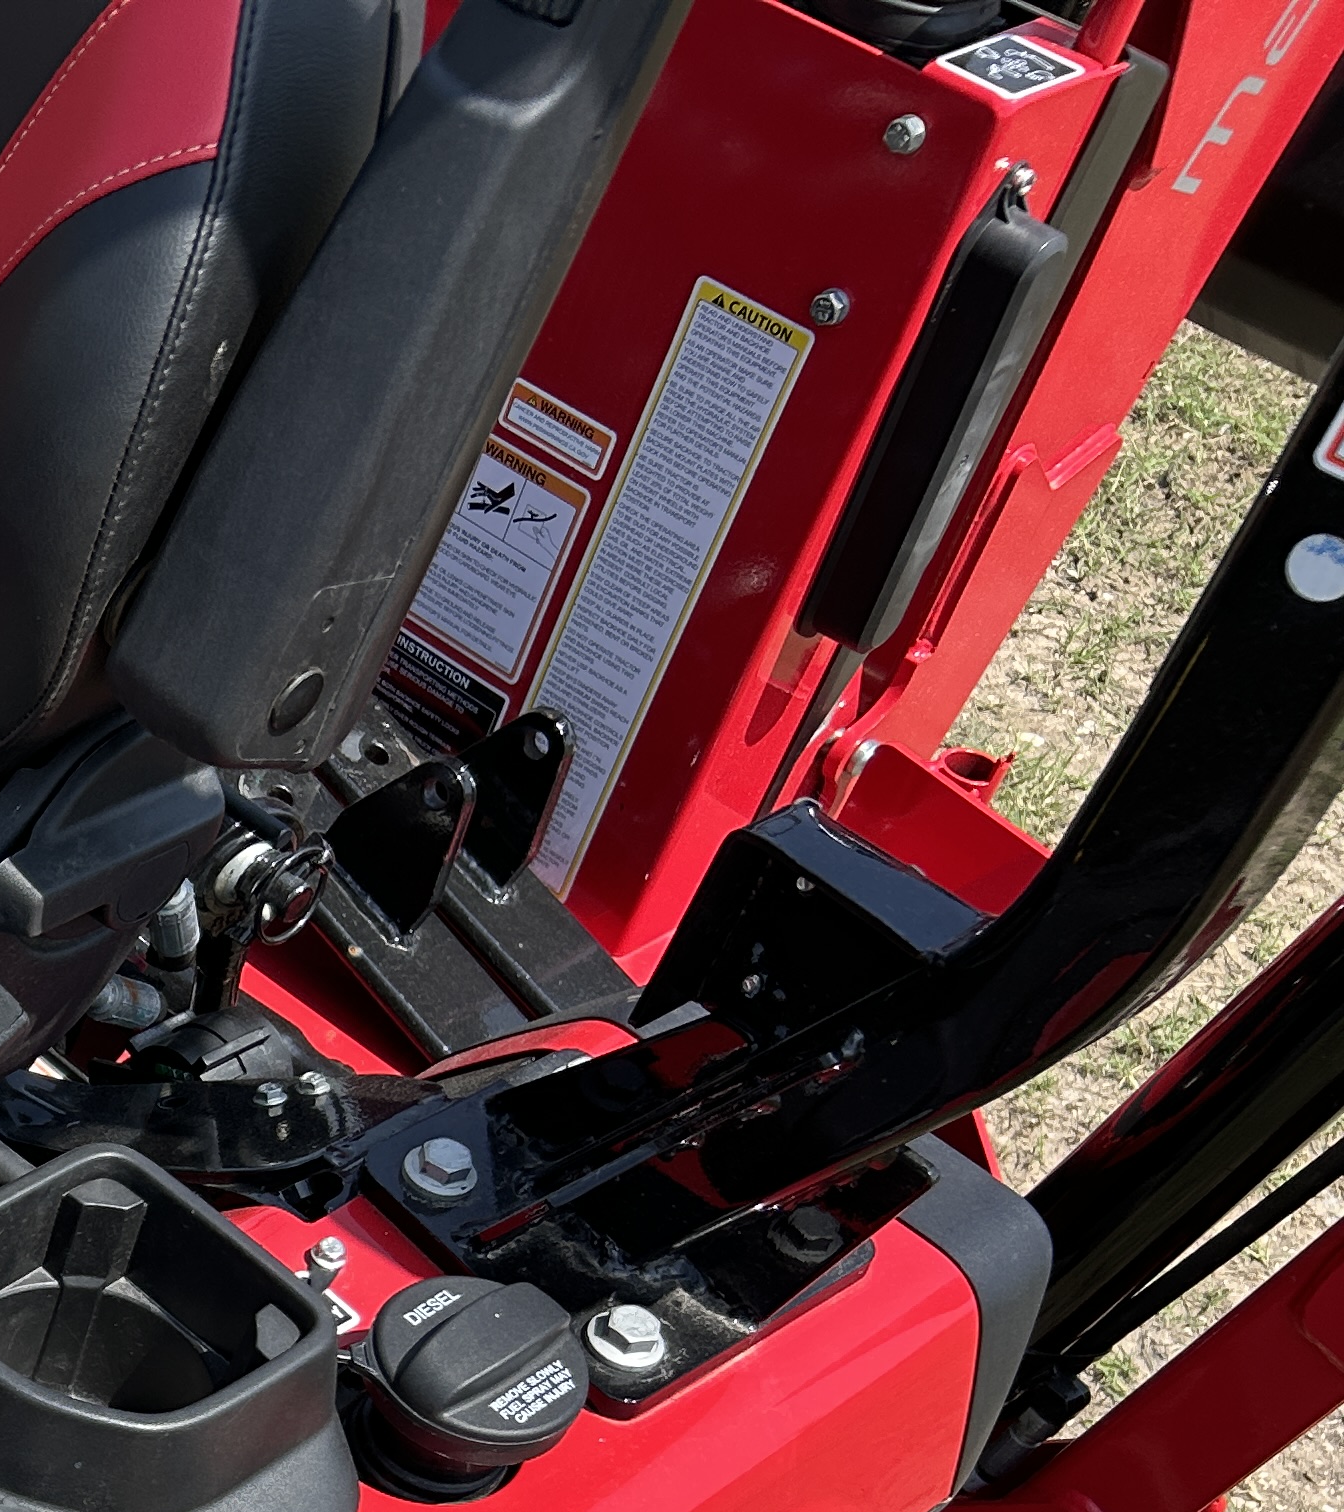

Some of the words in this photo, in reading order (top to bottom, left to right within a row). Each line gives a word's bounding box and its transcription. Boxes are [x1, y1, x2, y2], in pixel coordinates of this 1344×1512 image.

[727, 298, 793, 343] CAUTION
[538, 399, 595, 440] WARNING
[483, 440, 548, 487] WARNING
[394, 634, 471, 690] INSTRUCTION
[402, 1289, 462, 1327] DIESEL
[489, 1381, 530, 1411] REMOVE
[526, 1359, 563, 1386] SLOWLY
[499, 1400, 526, 1420] FUEL
[522, 1379, 552, 1403] SPRAY
[549, 1367, 572, 1385] MAY
[515, 1397, 548, 1424] CAUSE
[543, 1378, 576, 1404] INJURY
